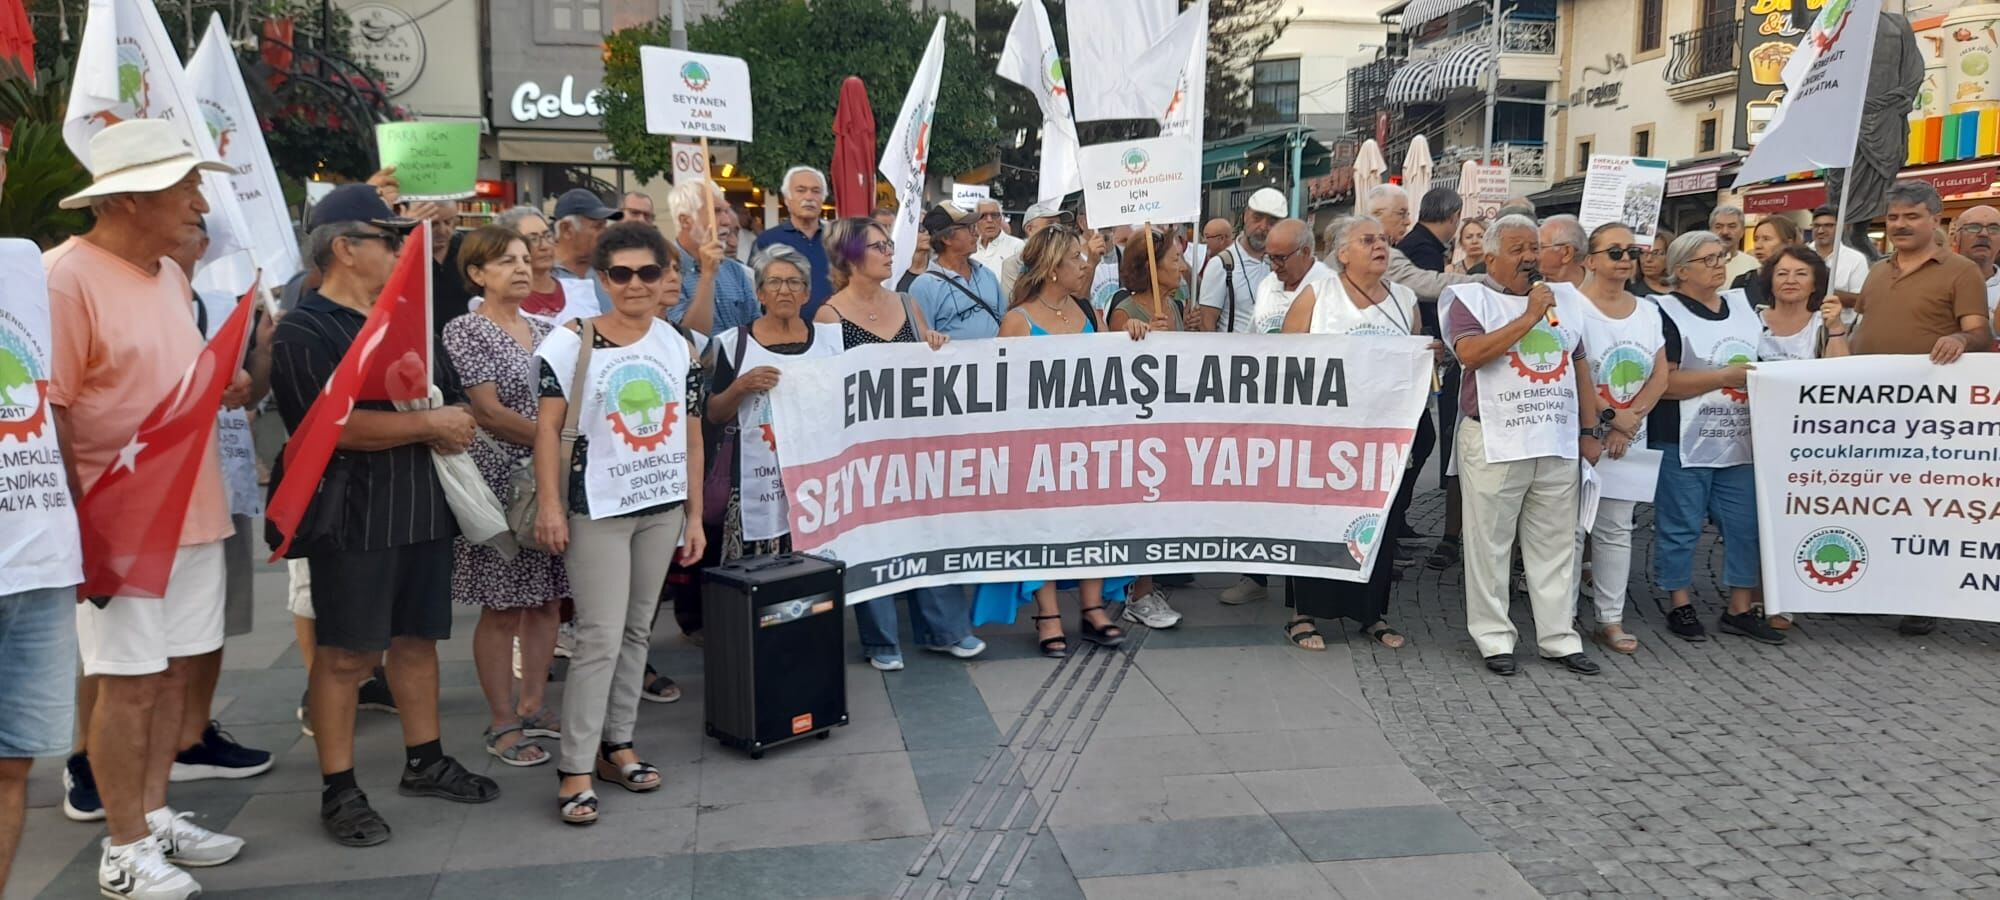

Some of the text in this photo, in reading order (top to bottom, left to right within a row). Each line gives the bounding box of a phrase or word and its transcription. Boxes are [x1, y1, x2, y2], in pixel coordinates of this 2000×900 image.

[672, 93, 727, 107] SEYYANEN
[690, 108, 713, 119] ZAM
[680, 120, 727, 133] YAPILSIN
[1096, 172, 1184, 191] SİZ DOYMADIĞINIZ
[1129, 189, 1149, 200] İÇİN
[1120, 201, 1161, 214] BİZ AÇIZ
[844, 347, 1349, 429] EMEKLİ MAAŞLARINA
[1497, 390, 1521, 402] TÜM
[1799, 384, 1957, 405] KENARDAN
[1, 406, 26, 419] 2017
[1505, 414, 1553, 428] ANTALYA
[1792, 414, 1896, 434] insanca
[637, 424, 659, 436] 2017
[754, 465, 777, 478] TÜM
[1787, 469, 1884, 487] eşit,özgür
[1889, 472, 1912, 485] ve
[795, 445, 1010, 535] SEYYANEN
[1026, 437, 1167, 502] ARTIŞ
[619, 484, 669, 508] ANTALYA
[1785, 491, 1912, 517] İNSANCA
[1891, 534, 1949, 557] TÜM
[871, 538, 1297, 584] TÜM EMEKLİLERİN SENDİKASI
